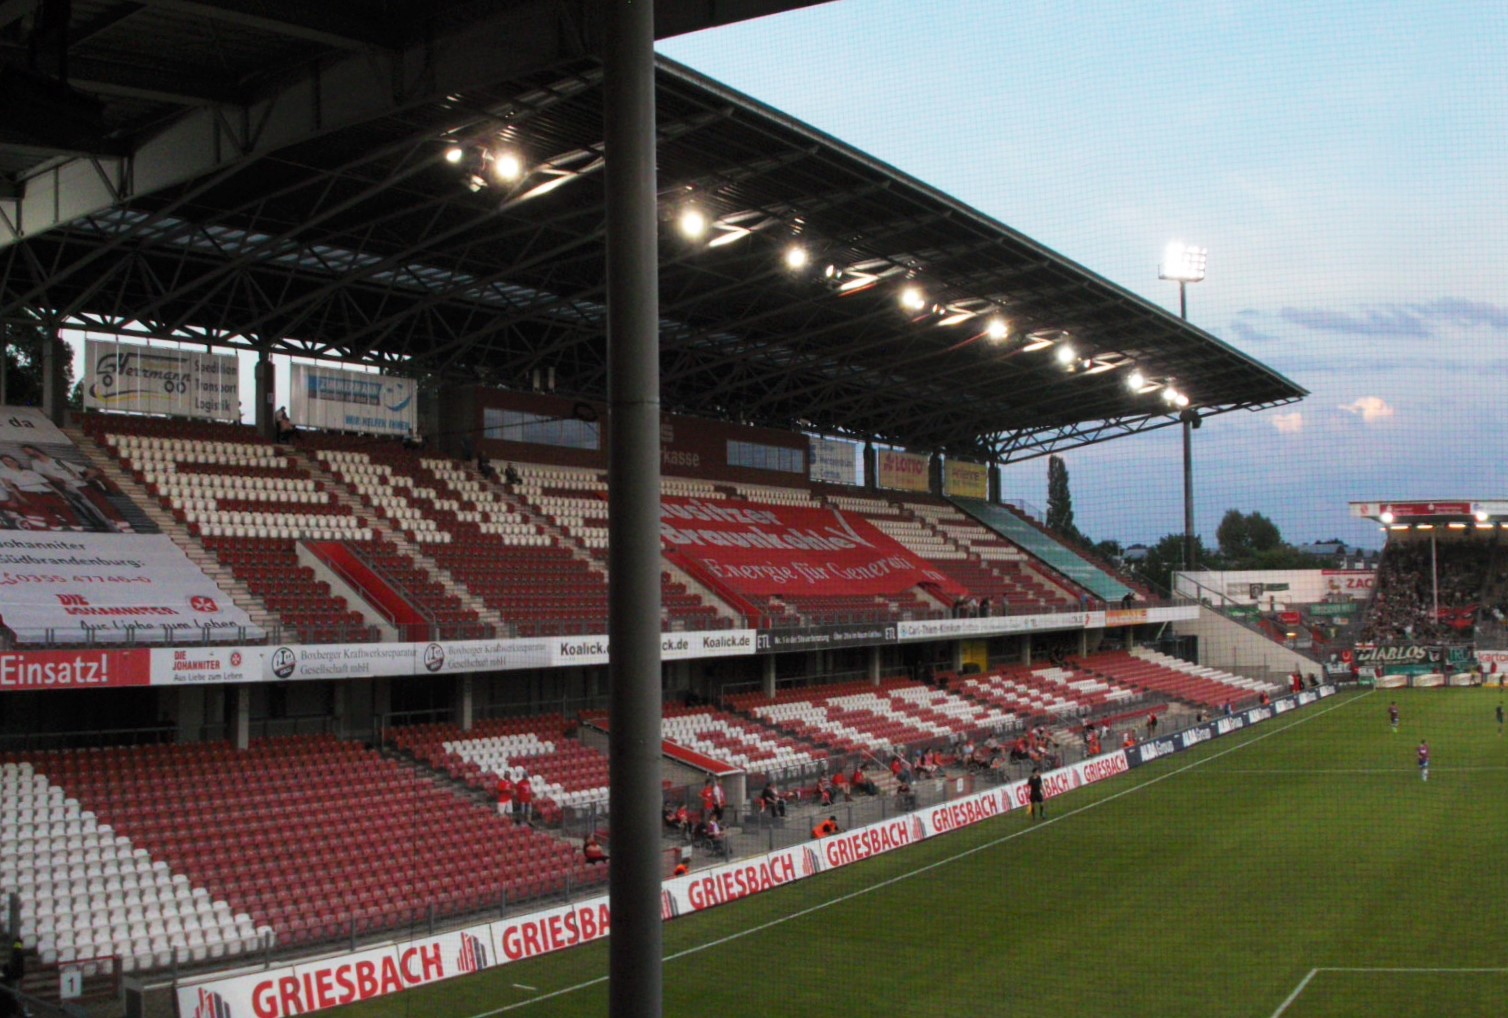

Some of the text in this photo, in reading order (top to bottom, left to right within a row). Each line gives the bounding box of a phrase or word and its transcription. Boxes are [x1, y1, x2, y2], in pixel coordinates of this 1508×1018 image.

[194, 397, 231, 413] Logistik
[661, 446, 701, 468] kasse
[703, 557, 798, 585] Energie
[702, 635, 750, 649] Koalick.de
[172, 659, 221, 671] JOHANNITER
[174, 650, 187, 660] DIE
[301, 649, 341, 662] Boxberger
[0, 653, 108, 685] Einsatz!
[173, 671, 244, 682] Aus Liebe zum Leben
[300, 662, 348, 675] Gesellschaft
[1083, 754, 1128, 783] GRIESBACH
[932, 793, 998, 832] GRIESBACH
[826, 821, 910, 867] GRIESBACH
[689, 853, 796, 911] GRIESBACH
[502, 903, 610, 961] GRIESBA
[67, 977, 75, 993] 1
[252, 943, 445, 1018] GRIESBACH
